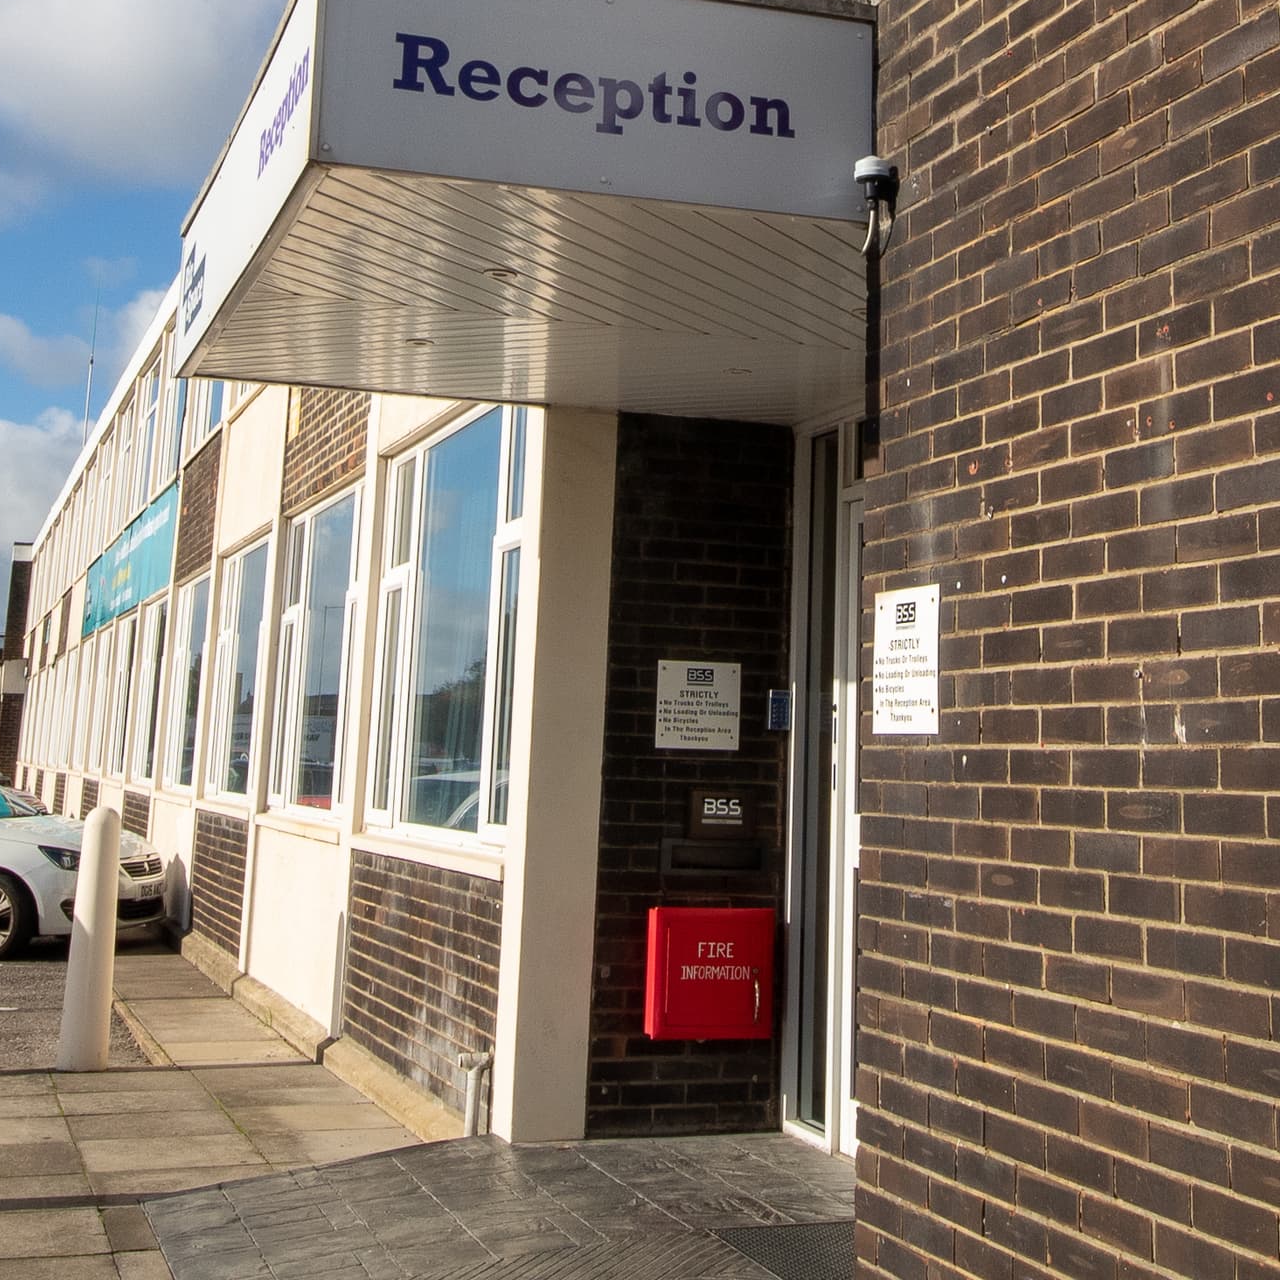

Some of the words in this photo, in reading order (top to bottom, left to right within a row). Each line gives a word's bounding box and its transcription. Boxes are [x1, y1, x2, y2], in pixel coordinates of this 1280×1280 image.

[393, 32, 796, 139] Reception
[257, 45, 310, 180] Reception
[896, 603, 915, 622] BSS
[889, 638, 920, 651] STRICTLY
[688, 669, 713, 681] BSS
[680, 690, 719, 699] STRICTLY
[704, 798, 741, 815] BSS
[697, 942, 734, 958] FIRE
[680, 965, 750, 980] INFORMATION
